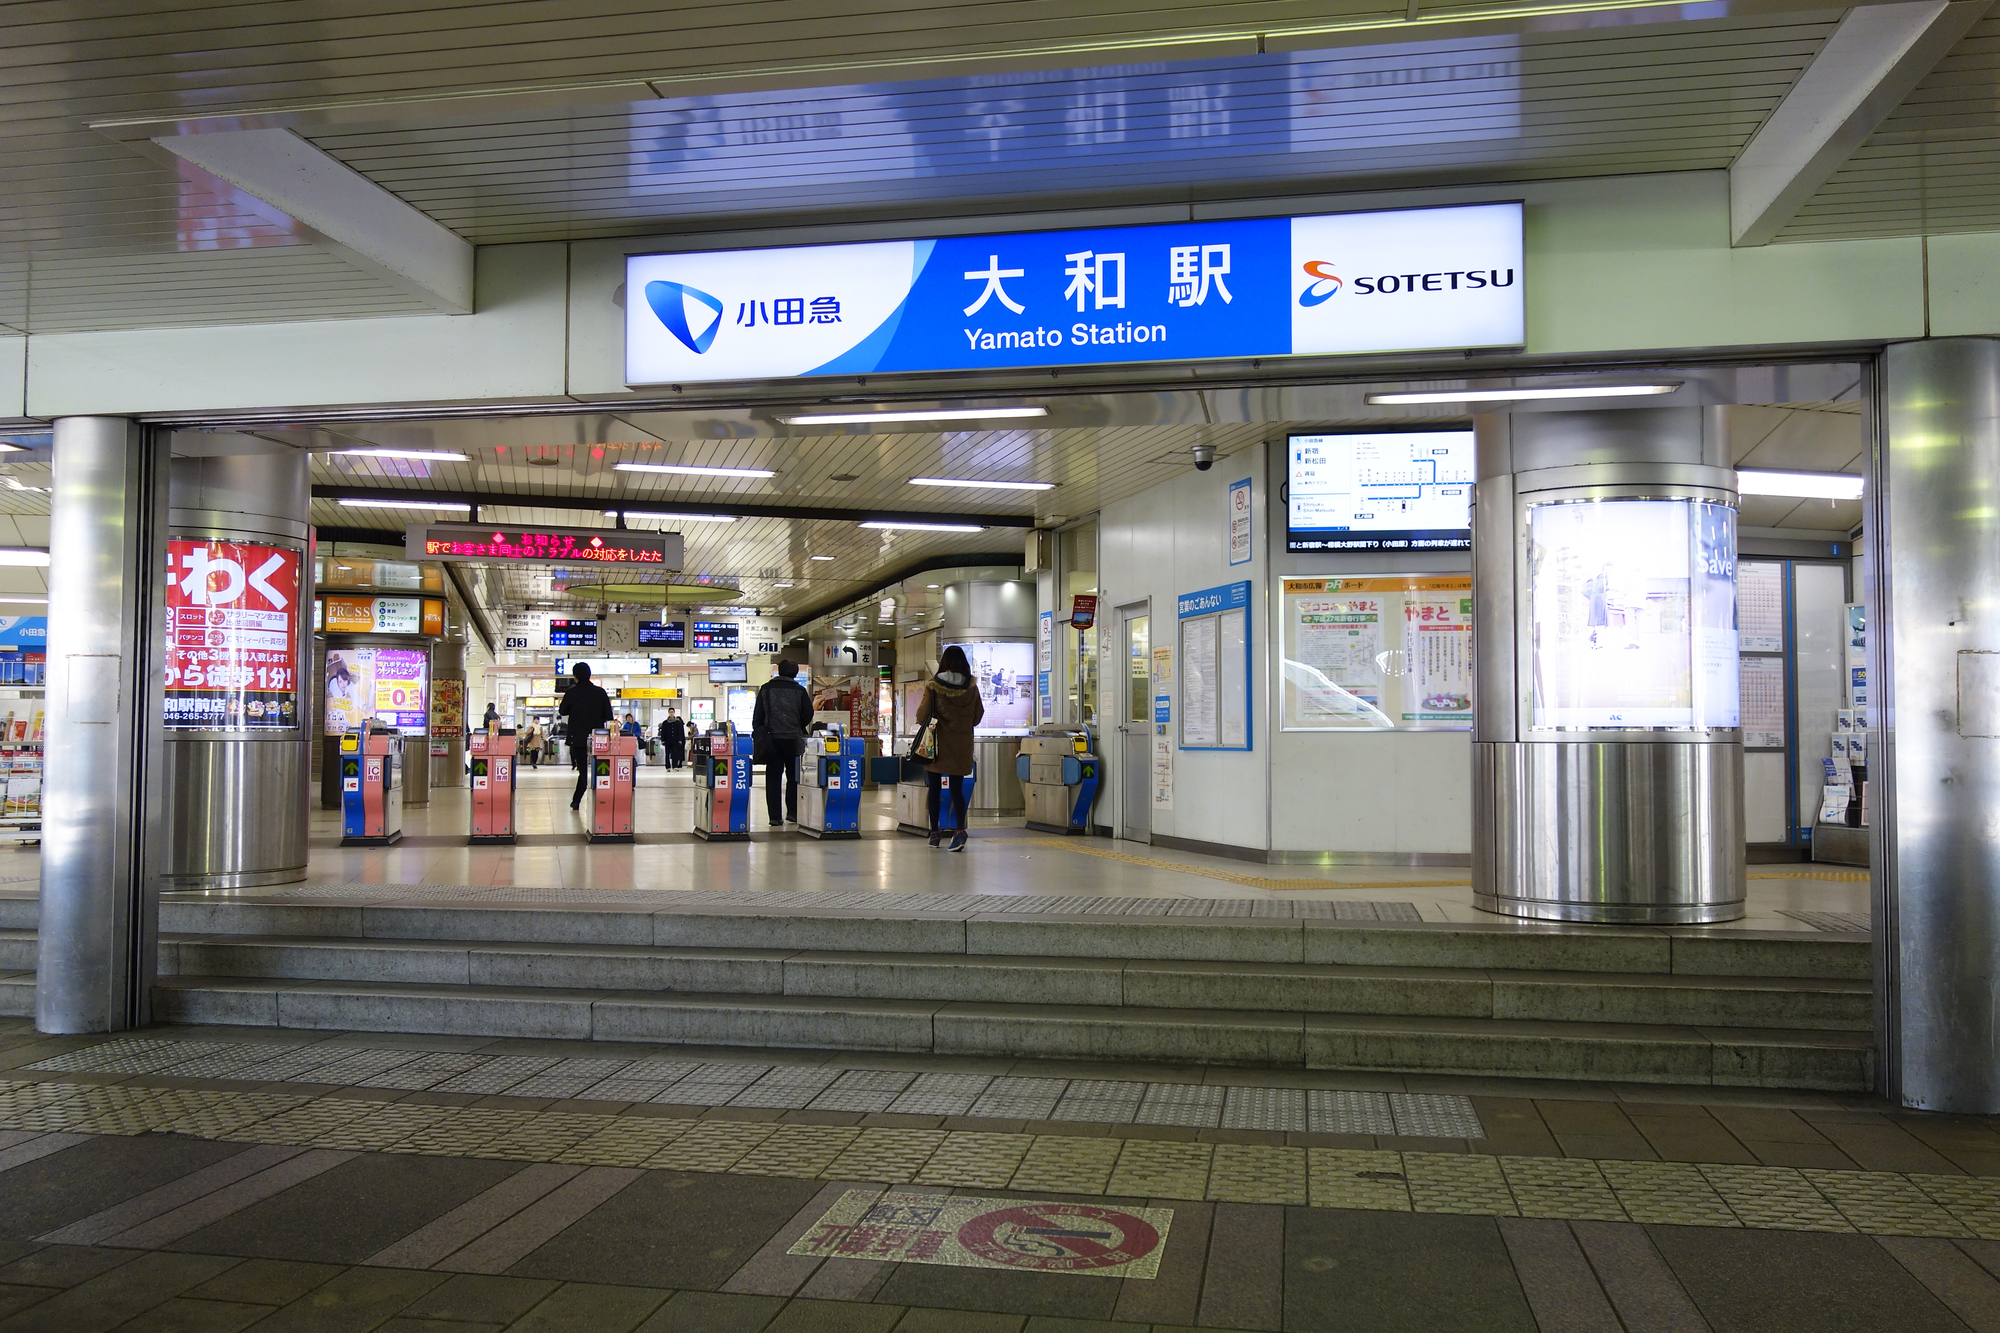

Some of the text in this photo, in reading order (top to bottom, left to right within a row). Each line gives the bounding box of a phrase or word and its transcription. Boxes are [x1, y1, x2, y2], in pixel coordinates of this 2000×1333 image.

[963, 244, 1233, 316] 大和駅
[1354, 268, 1514, 296] SOTETSU
[736, 293, 842, 326] 小田急
[964, 320, 1167, 352] Yamato Station
[1304, 447, 1319, 455] 新宿
[1304, 457, 1327, 465] 新松田
[521, 532, 576, 547] お知らせ
[1697, 552, 1733, 576] Save
[1344, 581, 1364, 589] ボード
[1179, 594, 1222, 614] 営業のごあんない
[226, 611, 285, 621] サラリーマン金太郎
[329, 606, 371, 617] PROSS
[1405, 606, 1450, 622] やまと
[508, 639, 526, 647] 4 3
[761, 643, 776, 651] 2 1
[862, 653, 870, 663] 左
[392, 689, 405, 707] 0
[163, 712, 225, 720] 046-265-3777
[368, 766, 380, 775] IC
[496, 766, 508, 775] IC
[618, 766, 630, 775] IC
